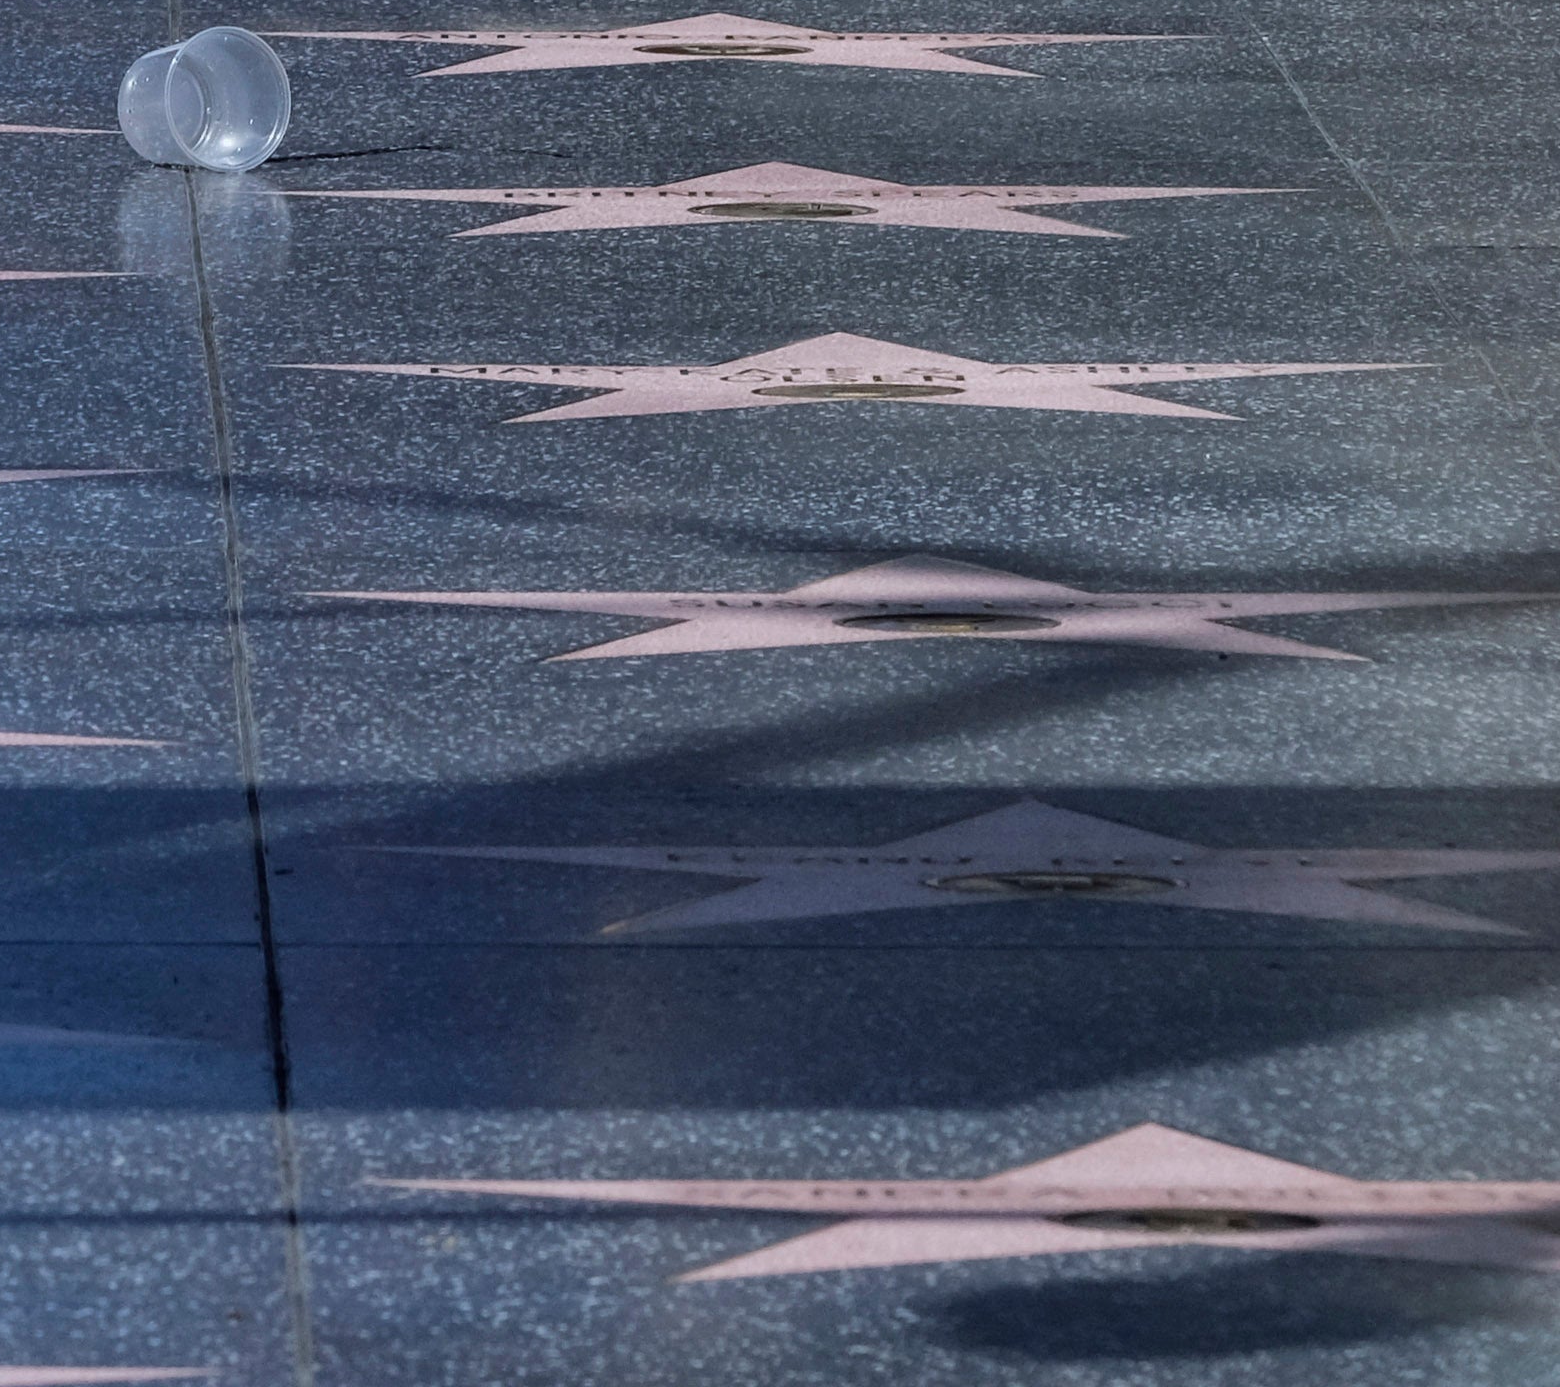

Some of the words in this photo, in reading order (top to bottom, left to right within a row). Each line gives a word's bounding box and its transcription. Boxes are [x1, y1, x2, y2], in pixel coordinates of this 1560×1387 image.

[993, 366, 1277, 374] ASHLEY
[719, 375, 966, 383] OLSEN
[668, 599, 924, 608] SUSAN
